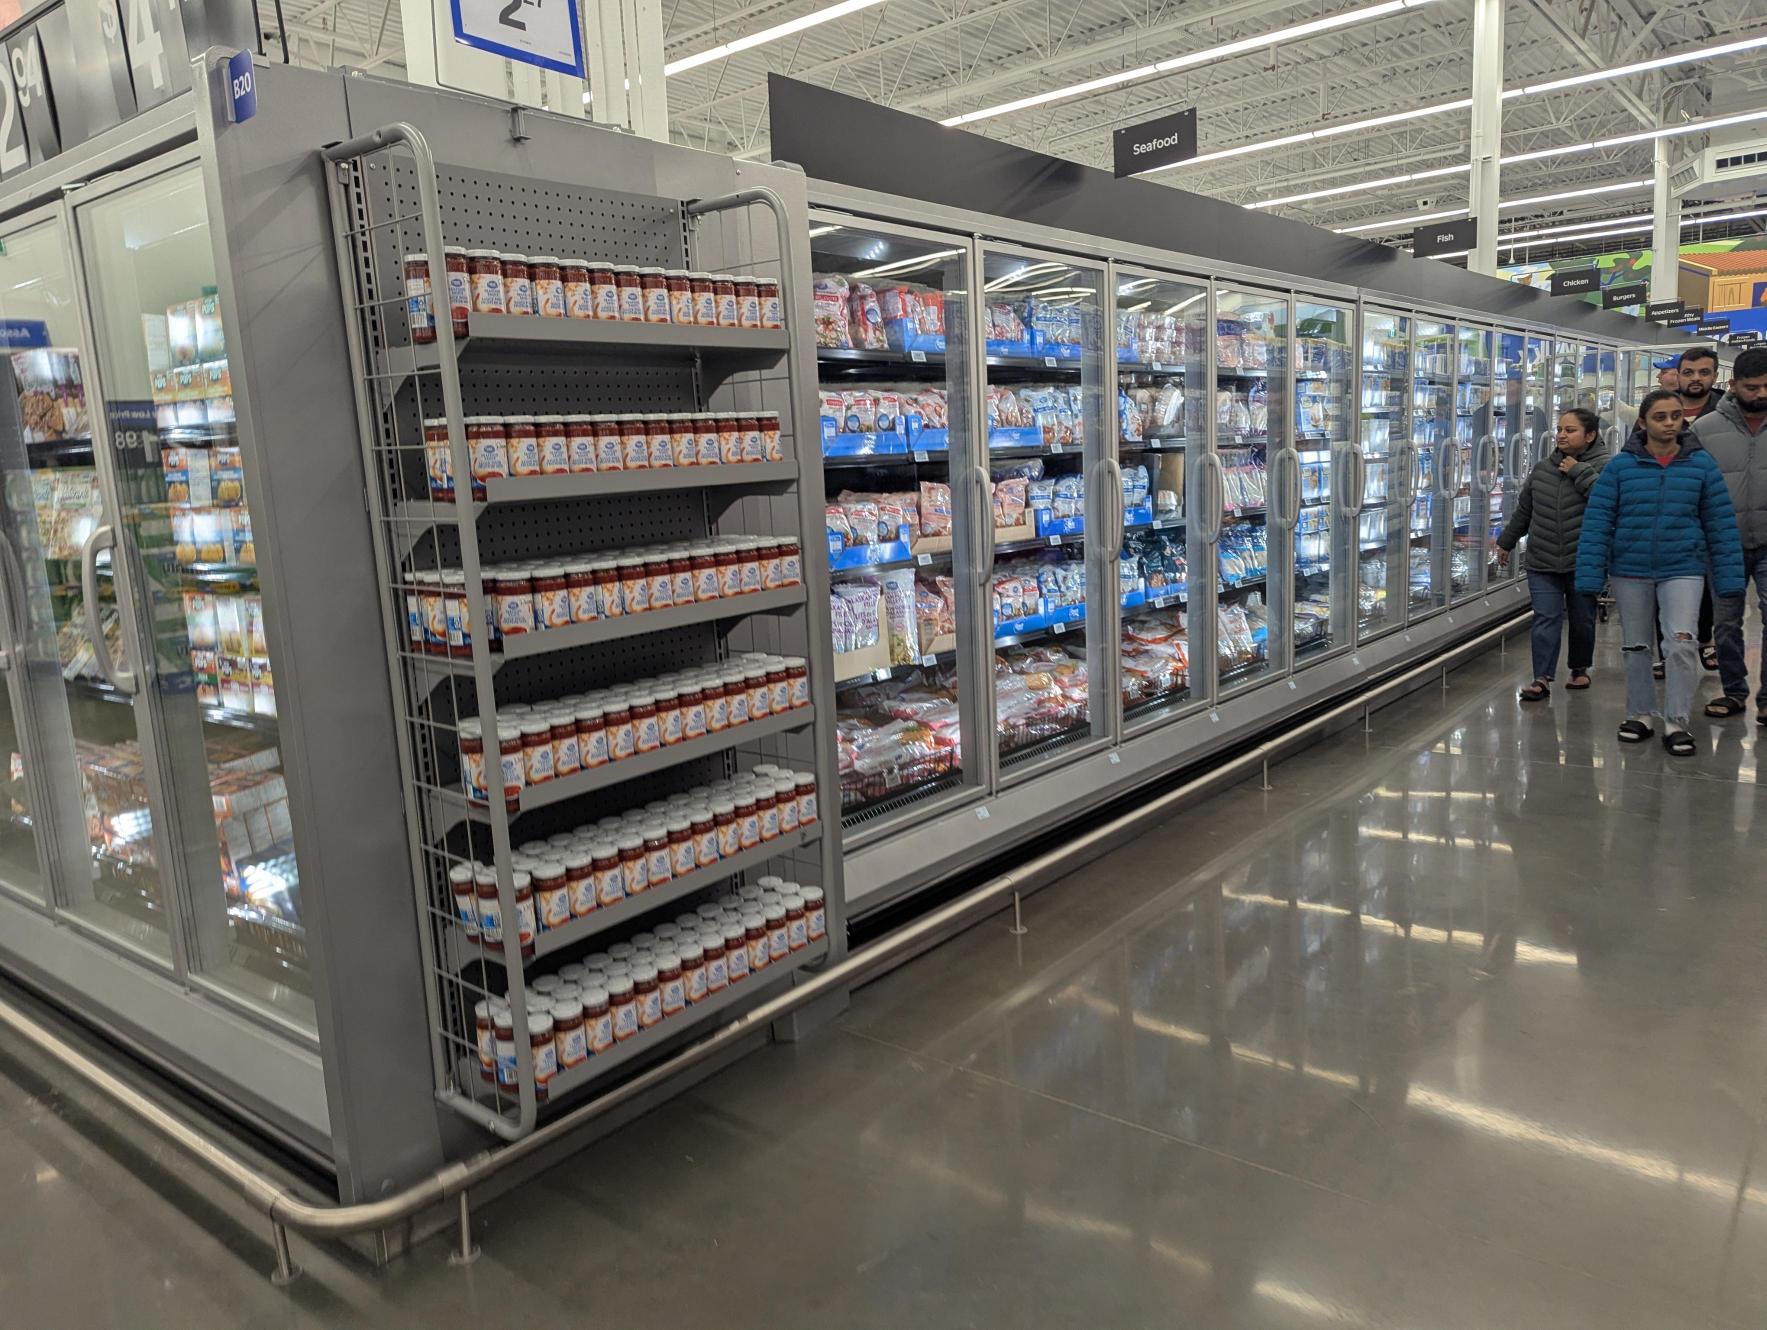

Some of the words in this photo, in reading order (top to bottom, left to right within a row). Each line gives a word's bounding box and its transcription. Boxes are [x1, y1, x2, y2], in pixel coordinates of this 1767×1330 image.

[233, 71, 251, 100] B20
[1133, 132, 1178, 156] Seafood
[1437, 233, 1454, 243] Fish
[1563, 278, 1589, 287] Chicken
[1613, 293, 1636, 302] Burgers
[1651, 308, 1680, 316] Appetizers
